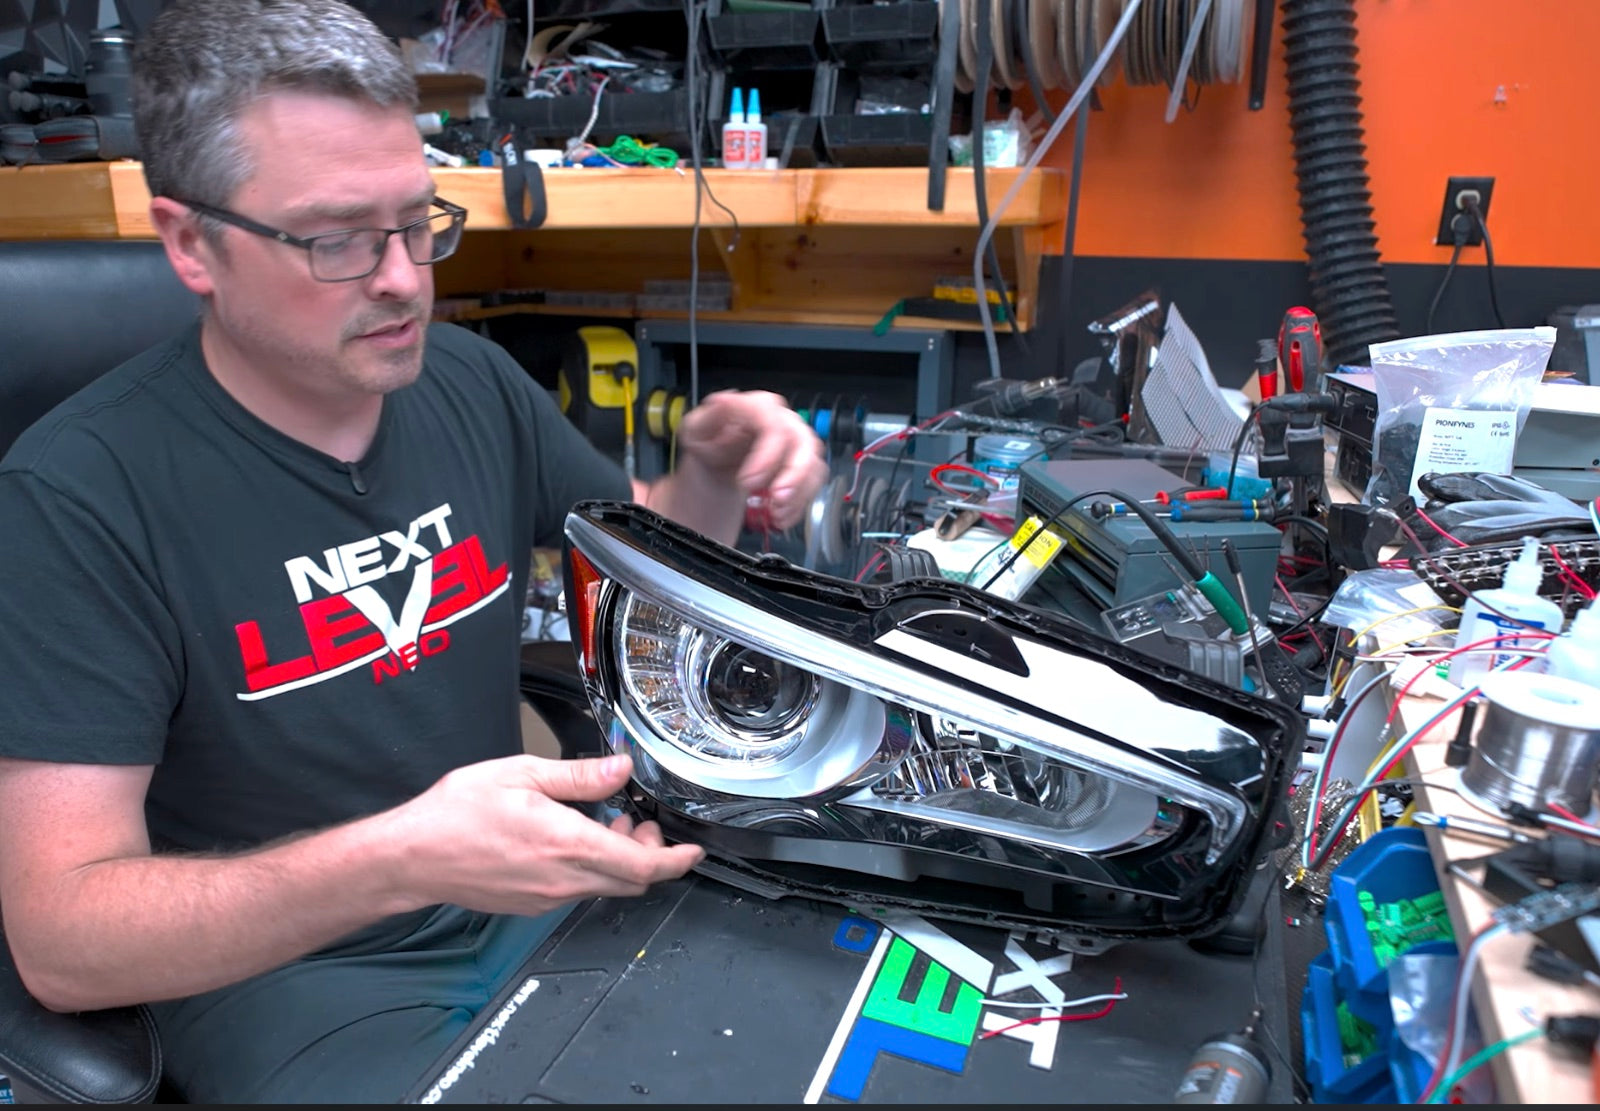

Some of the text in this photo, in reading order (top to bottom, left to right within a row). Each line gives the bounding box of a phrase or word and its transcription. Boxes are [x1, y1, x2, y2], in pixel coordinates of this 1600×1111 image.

[284, 502, 452, 603] NEXT
[234, 534, 509, 692] LEVEL
[371, 629, 450, 685] NEO
